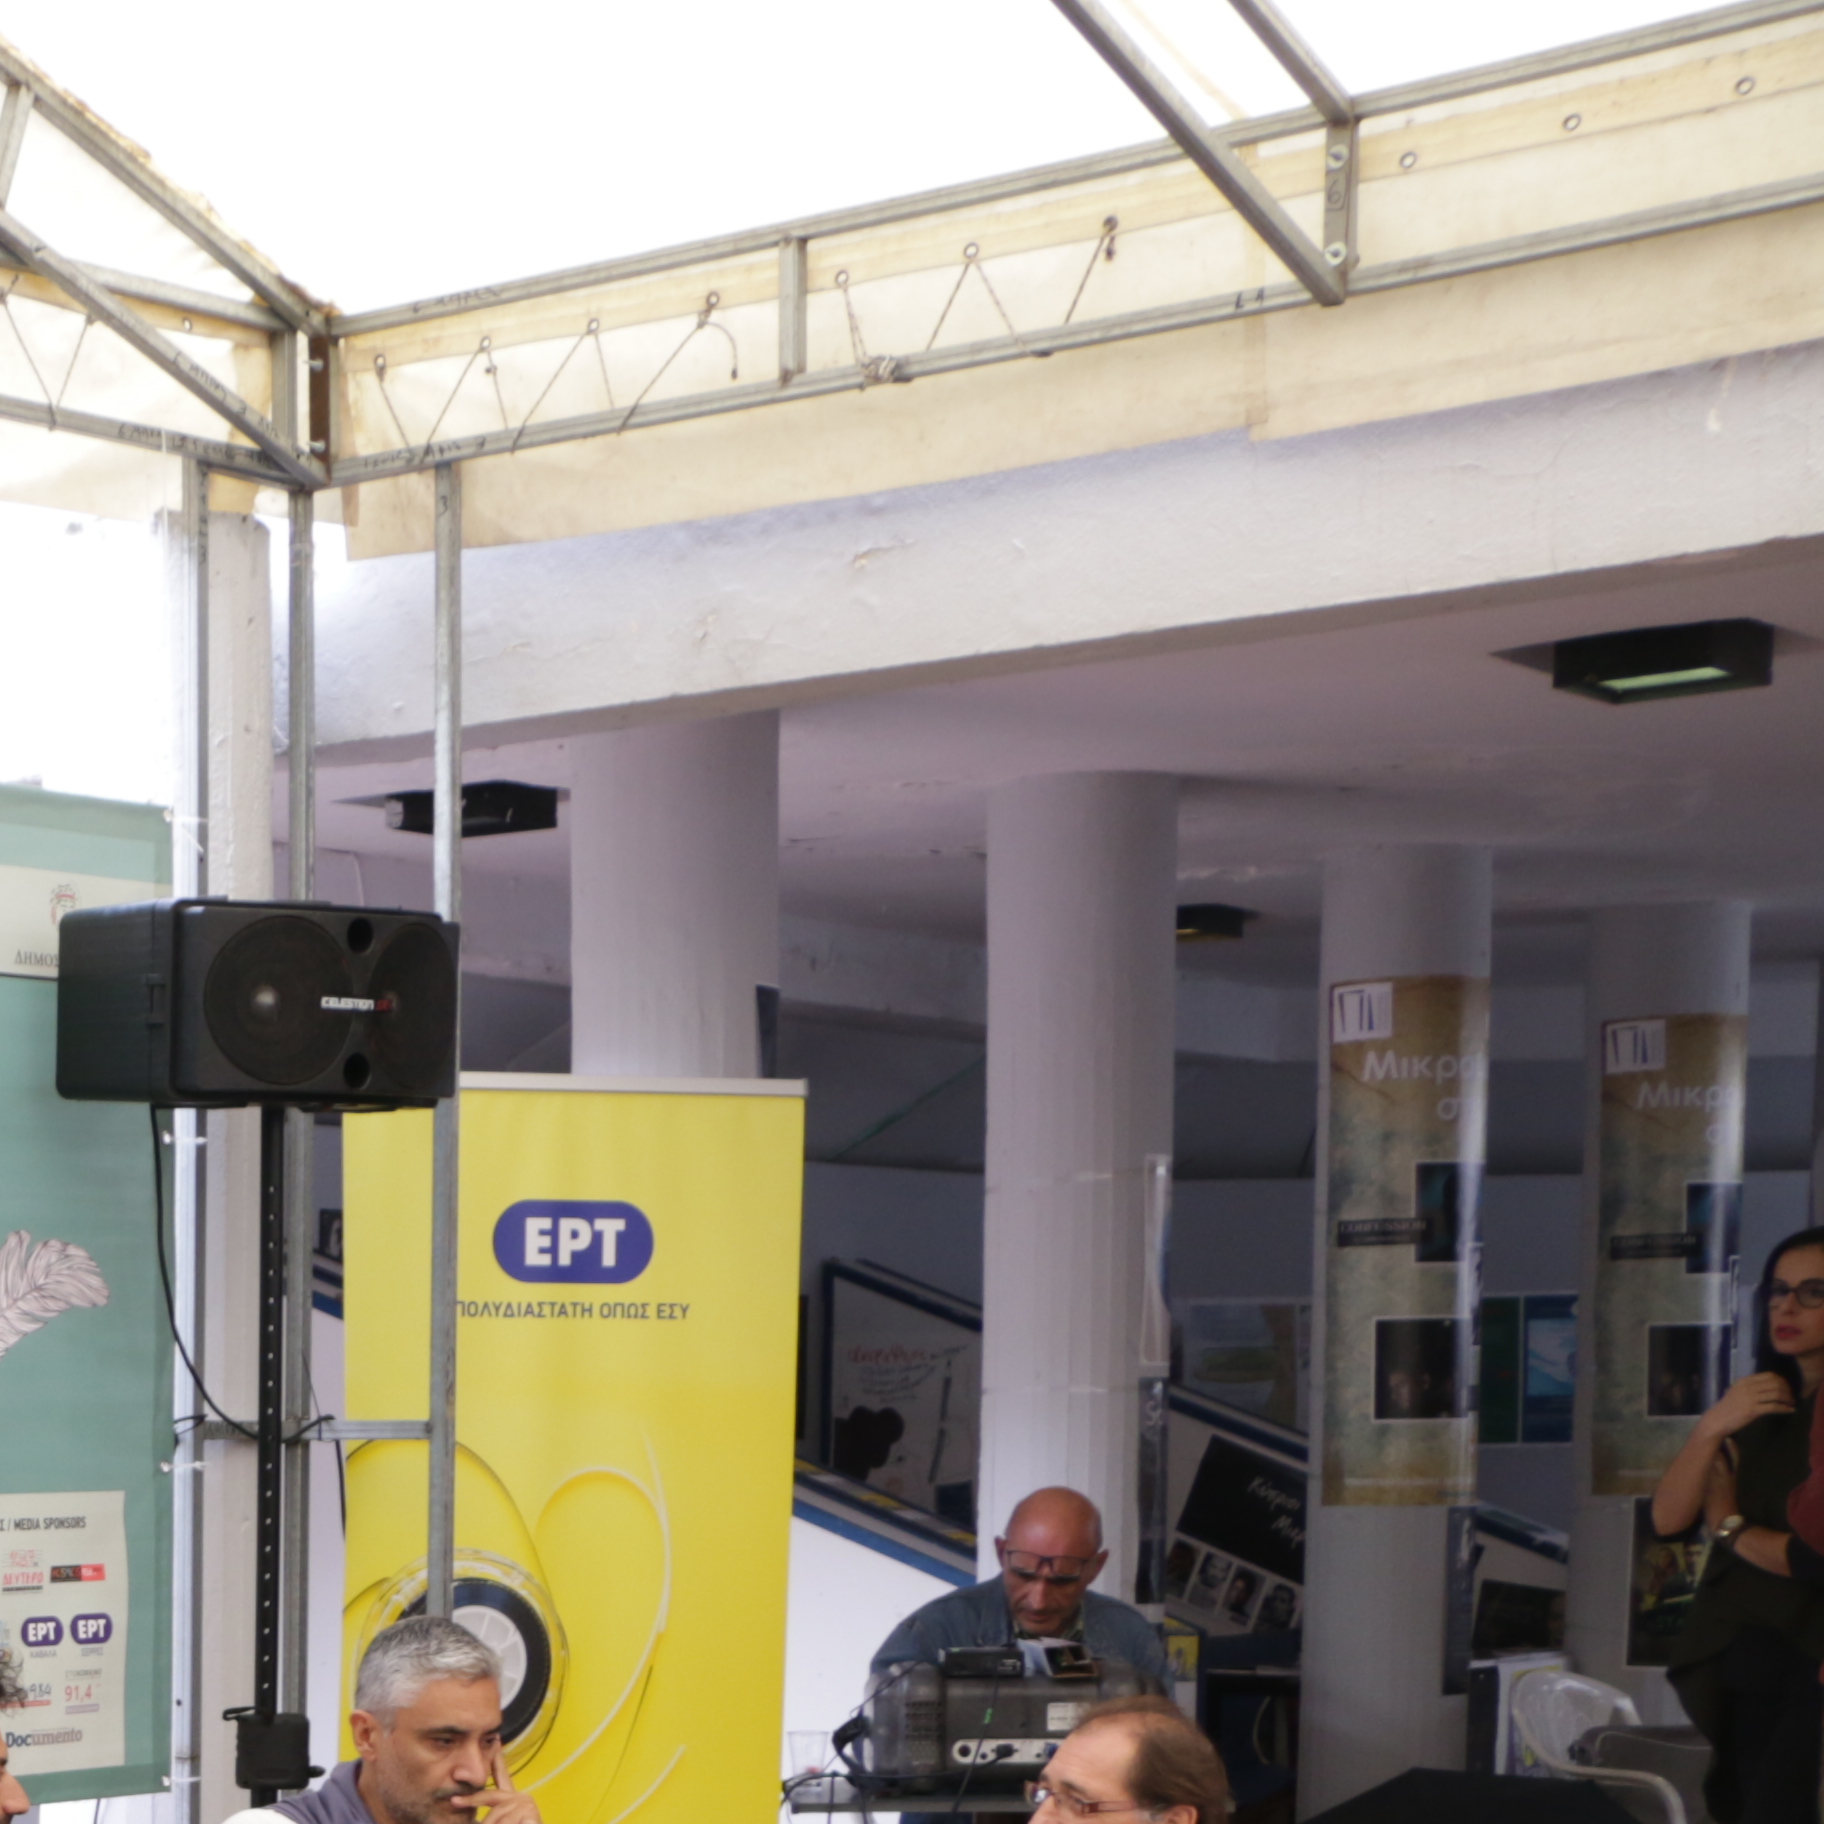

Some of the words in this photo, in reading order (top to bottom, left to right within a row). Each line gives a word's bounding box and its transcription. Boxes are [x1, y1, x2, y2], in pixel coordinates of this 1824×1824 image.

[524, 1216, 626, 1267] ΕΡΤ
[599, 1302, 651, 1319] ΟΠΩΣ
[656, 1303, 690, 1320] ΕΣΥ
[14, 1517, 40, 1531] MEDIA
[43, 1515, 87, 1530] SPONSORS
[28, 1622, 56, 1642] ΕΡΤ
[77, 1619, 106, 1638] ΕΡΤ
[5, 1728, 83, 1748] Documento
